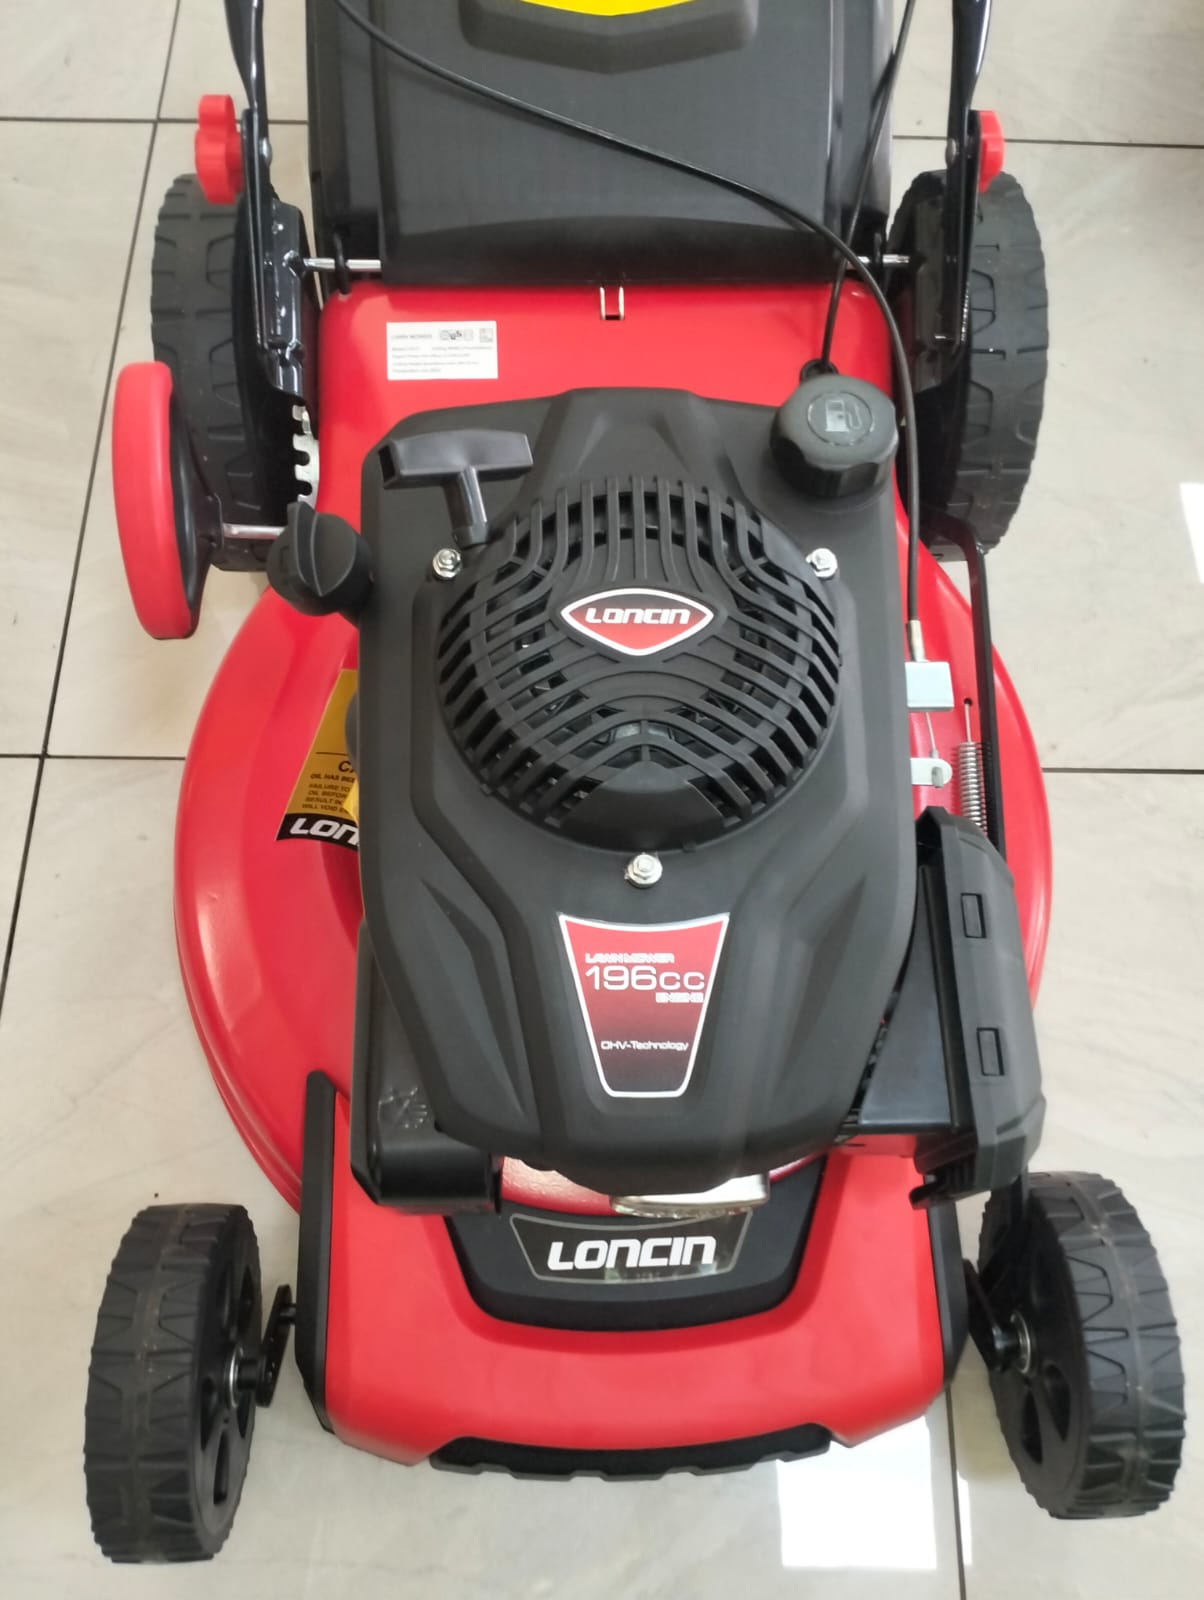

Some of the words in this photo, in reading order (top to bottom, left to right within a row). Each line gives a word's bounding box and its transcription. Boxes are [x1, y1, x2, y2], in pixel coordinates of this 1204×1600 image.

[585, 607, 691, 625] LONCIN
[289, 817, 359, 846] LON
[585, 965, 705, 991] 196cc
[547, 1235, 717, 1271] LONCIN
